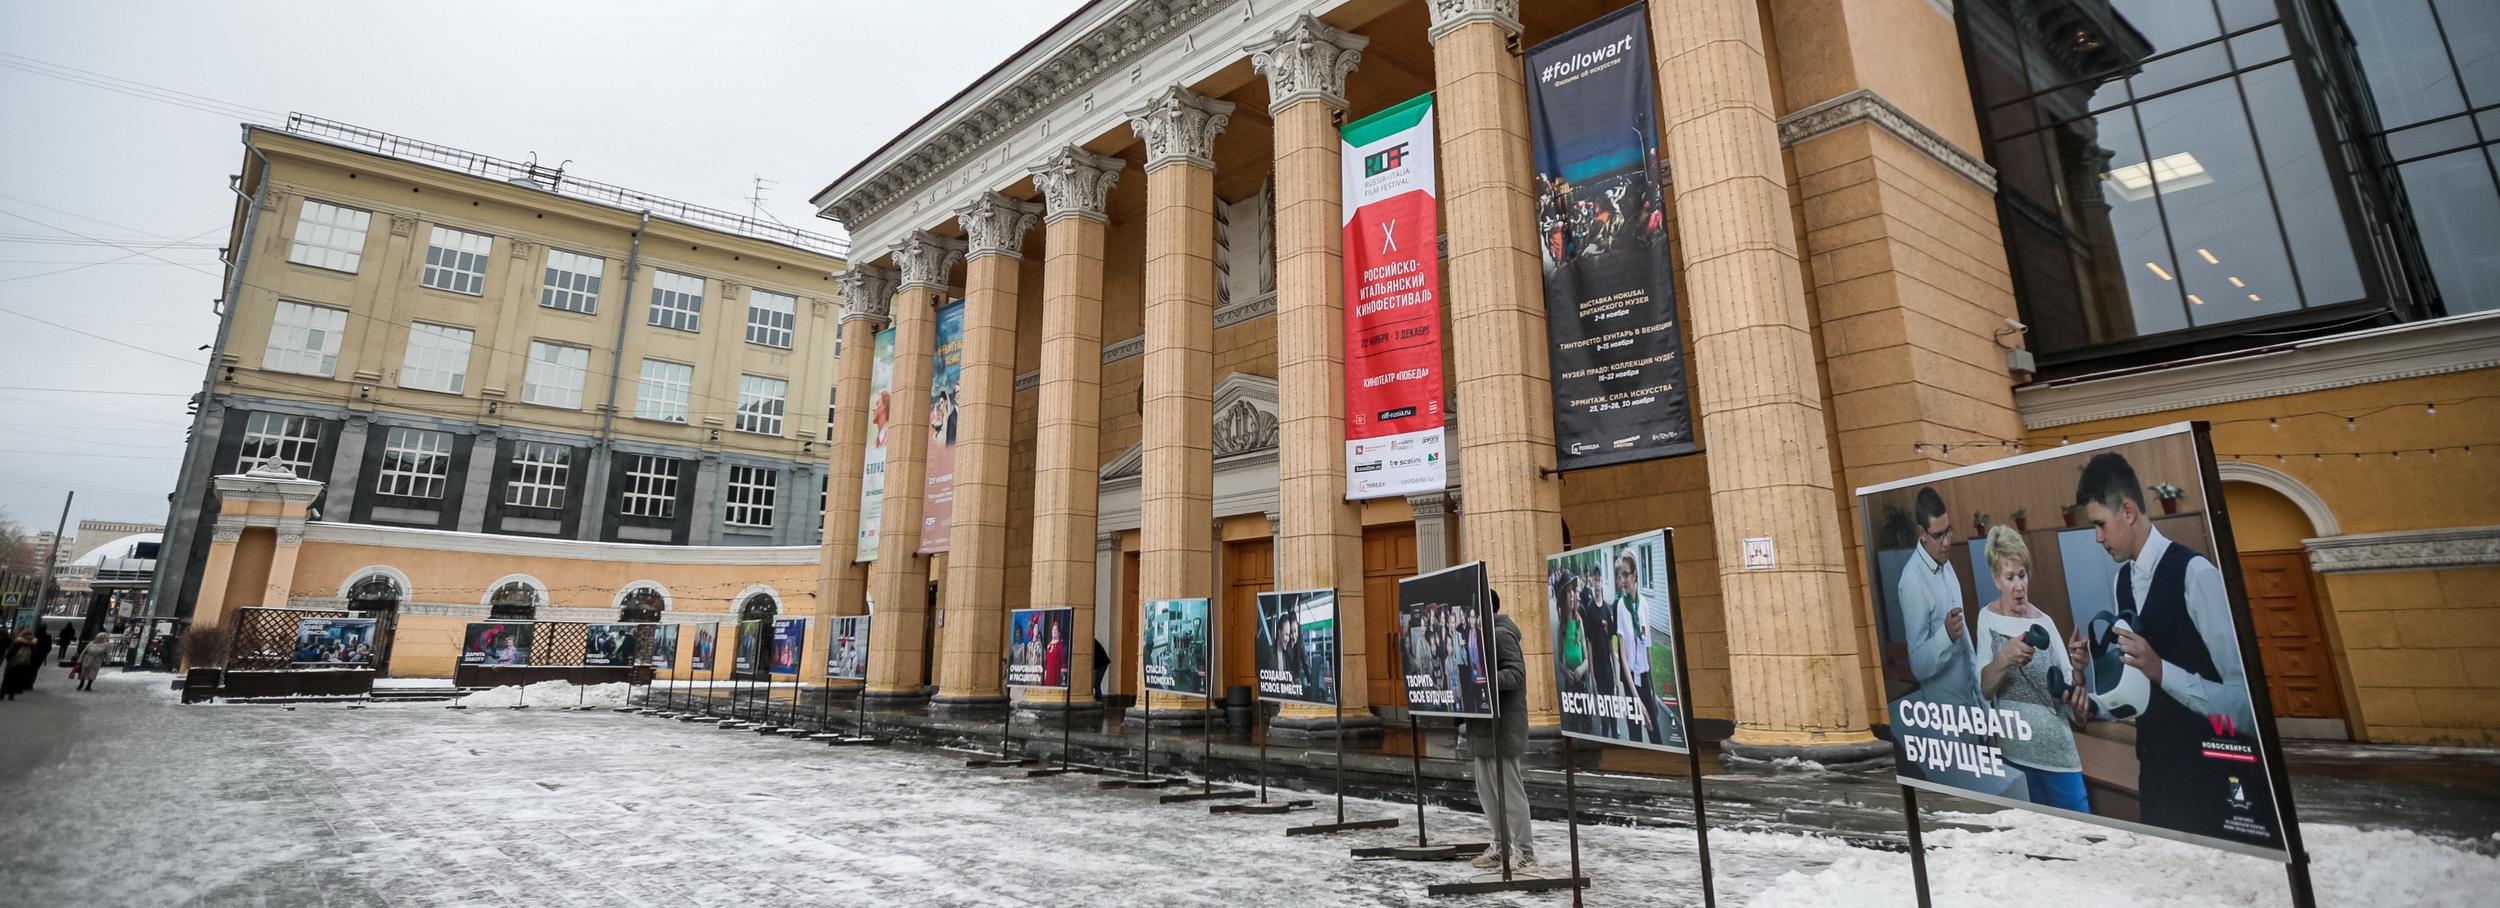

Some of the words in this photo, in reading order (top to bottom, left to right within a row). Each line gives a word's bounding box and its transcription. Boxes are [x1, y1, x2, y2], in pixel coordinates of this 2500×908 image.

[1542, 34, 1632, 83] #followart
[1001, 0, 1253, 164] ПОБЕДА
[1364, 187, 1380, 197] FILM
[1381, 178, 1408, 192] FESTIVAL
[1382, 218, 1397, 255] X
[1364, 259, 1420, 283] РОССИЙСКО-
[1360, 272, 1424, 301] ИТАЛЬЯНСКИЙ
[1356, 289, 1432, 317] КИНОФЕСТИВАЛЬ
[1579, 302, 1624, 318] БРИТАНСКОГО
[1625, 296, 1649, 305] МУЗЕЯ
[1580, 296, 1612, 309] ВЫСТАВКА
[1613, 289, 1644, 300] HOKUSAI
[1606, 309, 1630, 319] ноября
[1369, 333, 1389, 346] НОЯБРЯ
[1394, 331, 1399, 340] 3
[1401, 325, 1430, 339] ДЕКАБРЯ
[1560, 337, 1602, 350] ТИНТОРЕТТО:
[1603, 329, 1633, 341] БУНТАРЬ
[1642, 321, 1672, 334] ВЕНЕЦИИ
[1610, 339, 1634, 349] ноября
[1562, 367, 1586, 380] МУЗЕЙ
[1587, 366, 1610, 376] ПРАДО:
[1611, 357, 1653, 371] КОЛЛЕКЦИЯ
[1654, 352, 1675, 363] ЧУДЕС
[1615, 369, 1639, 379] ноября
[1364, 374, 1395, 388] КИНОТЕАТР
[1396, 367, 1429, 381] «ПОБЕДА»
[1609, 391, 1629, 401] СИЛА
[1630, 384, 1673, 398] ИСКУССТВА
[1632, 396, 1655, 406] ноября
[1146, 665, 1167, 674] СПАСАТЬ
[1260, 669, 1293, 682] СОЗДАВАТЬ
[1146, 675, 1151, 683] И
[1151, 675, 1175, 686] ПОМОГАТЬ
[1260, 682, 1280, 693] НОВОЕ
[1281, 684, 1303, 696] ВМЕСТЕ
[1406, 674, 1433, 688] ТВОРИТЬ
[1409, 690, 1426, 703] СВОЕ
[1426, 690, 1455, 705] БУДУЩЕЕ
[1561, 692, 1596, 716] ВЕСТИ
[1597, 694, 1646, 726] ВПЕРЕД
[1900, 699, 2033, 741] СОЗДАВАТЬ
[1904, 734, 2006, 778] БУДУЩЕЕ
[2202, 741, 2252, 753] НОВОСИБИРСК
